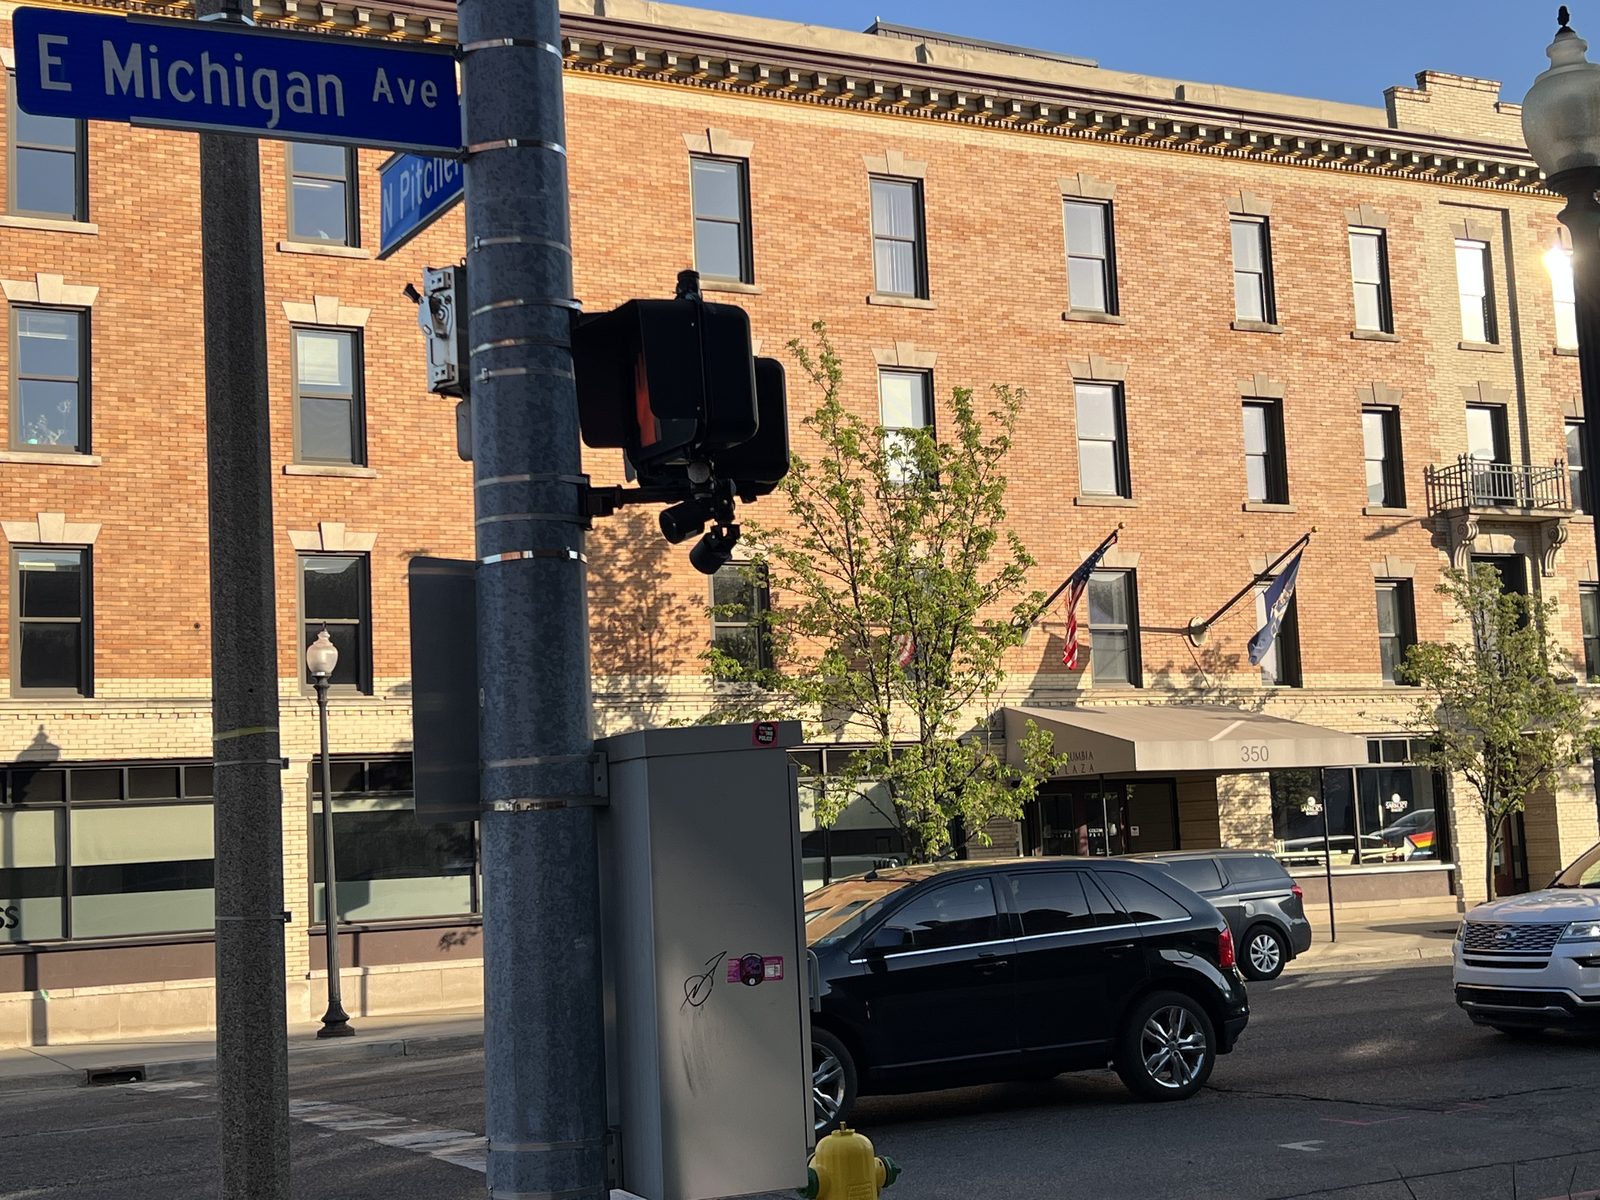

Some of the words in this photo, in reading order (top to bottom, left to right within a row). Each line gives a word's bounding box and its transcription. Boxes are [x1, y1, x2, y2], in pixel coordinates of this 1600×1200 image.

[37, 33, 73, 92] E
[102, 39, 346, 129] Michigan
[372, 67, 439, 109] Ave
[382, 182, 394, 234] N
[1240, 745, 1270, 762] 350
